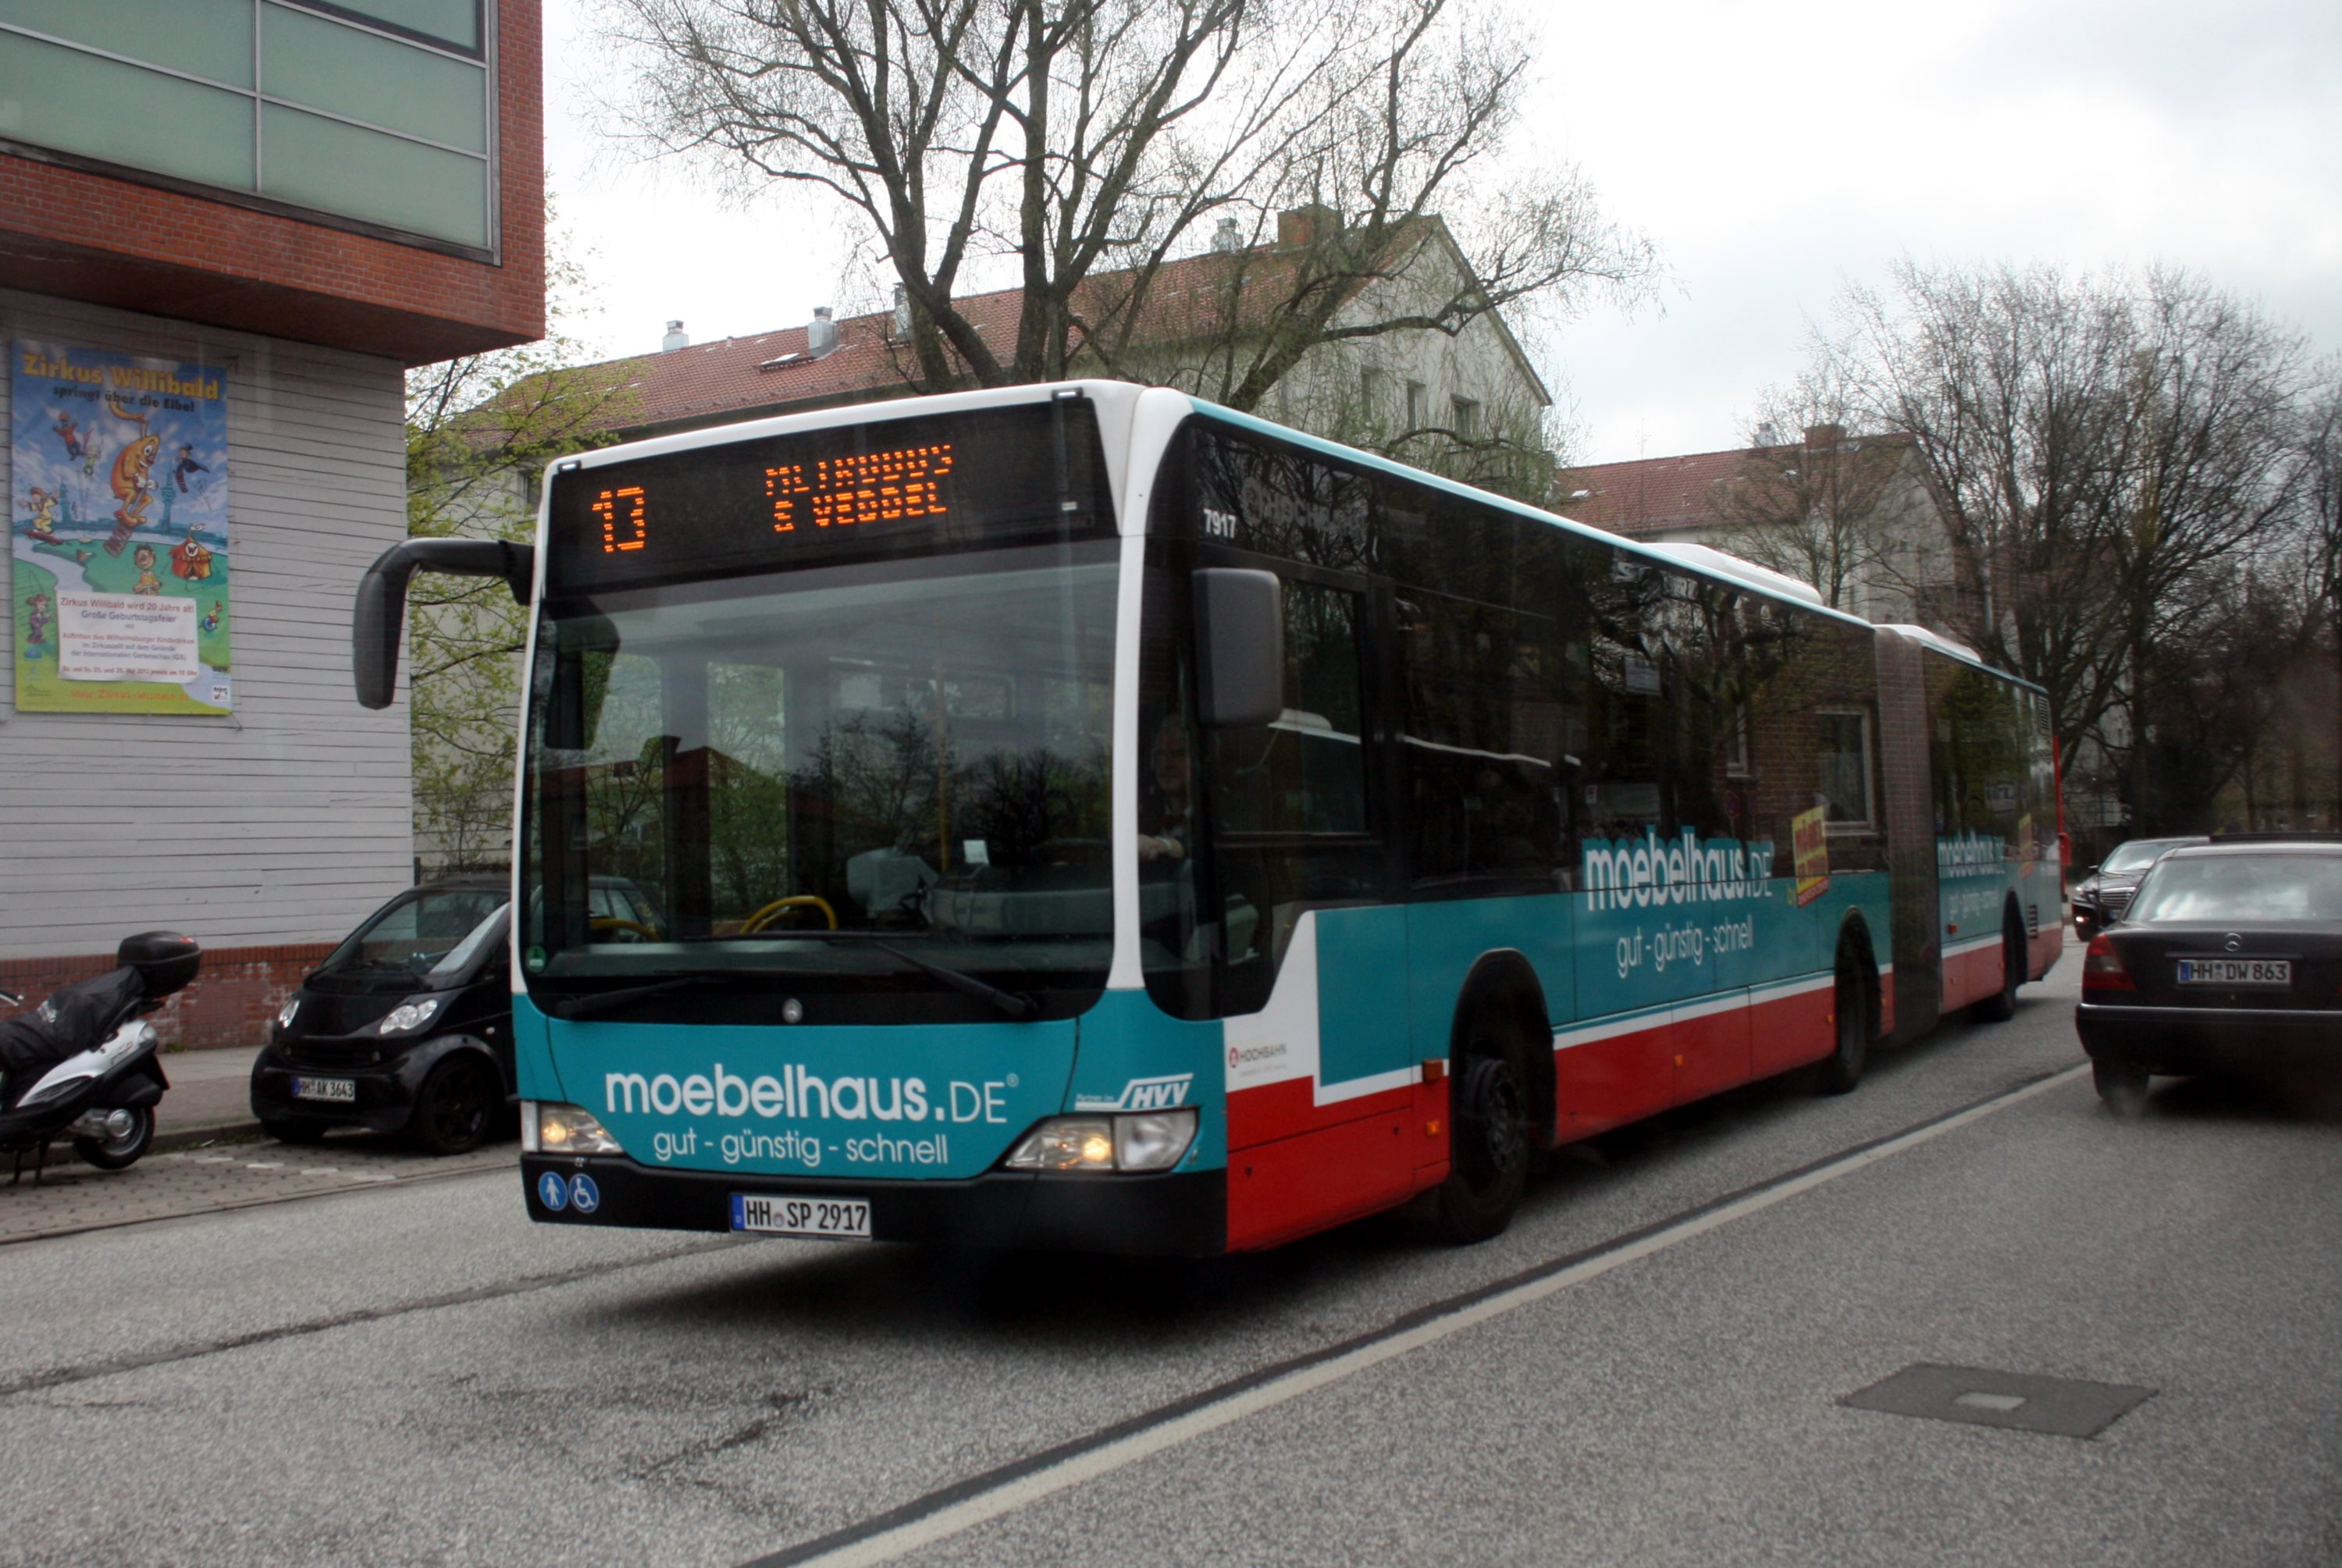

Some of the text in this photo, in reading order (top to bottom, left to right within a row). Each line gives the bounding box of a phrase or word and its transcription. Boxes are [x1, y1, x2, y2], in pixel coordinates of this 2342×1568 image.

[22, 354, 219, 400] Zirkus Willibald
[53, 385, 194, 413] springt über die Elbe!
[812, 482, 948, 528] VEDDEL
[1203, 508, 1237, 539] 7917
[60, 597, 88, 607] Zirkus
[91, 599, 125, 610] Willibald
[127, 601, 145, 610] wird
[147, 603, 157, 611] 20
[159, 603, 181, 613] Jahre
[81, 610, 177, 624] Große Geburtstagsfeier
[83, 650, 132, 659] Internationalen
[172, 653, 187, 662] (IGS)
[1586, 832, 1771, 911] moebelhaus.DE
[1617, 926, 1643, 978] gut
[1654, 921, 1703, 972] günstig
[1714, 913, 1753, 954] schnell
[2190, 963, 2287, 981] HH DW 863
[1240, 1043, 1287, 1063] HOCHBAHN
[329, 1082, 354, 1097] 3643
[1132, 1080, 1191, 1108] HVV
[653, 1127, 697, 1162] gut
[722, 1129, 820, 1168] günstig
[846, 1133, 949, 1164] schnell
[746, 1200, 771, 1227] HH
[787, 1202, 812, 1228] SP
[817, 1204, 867, 1231] 2917
